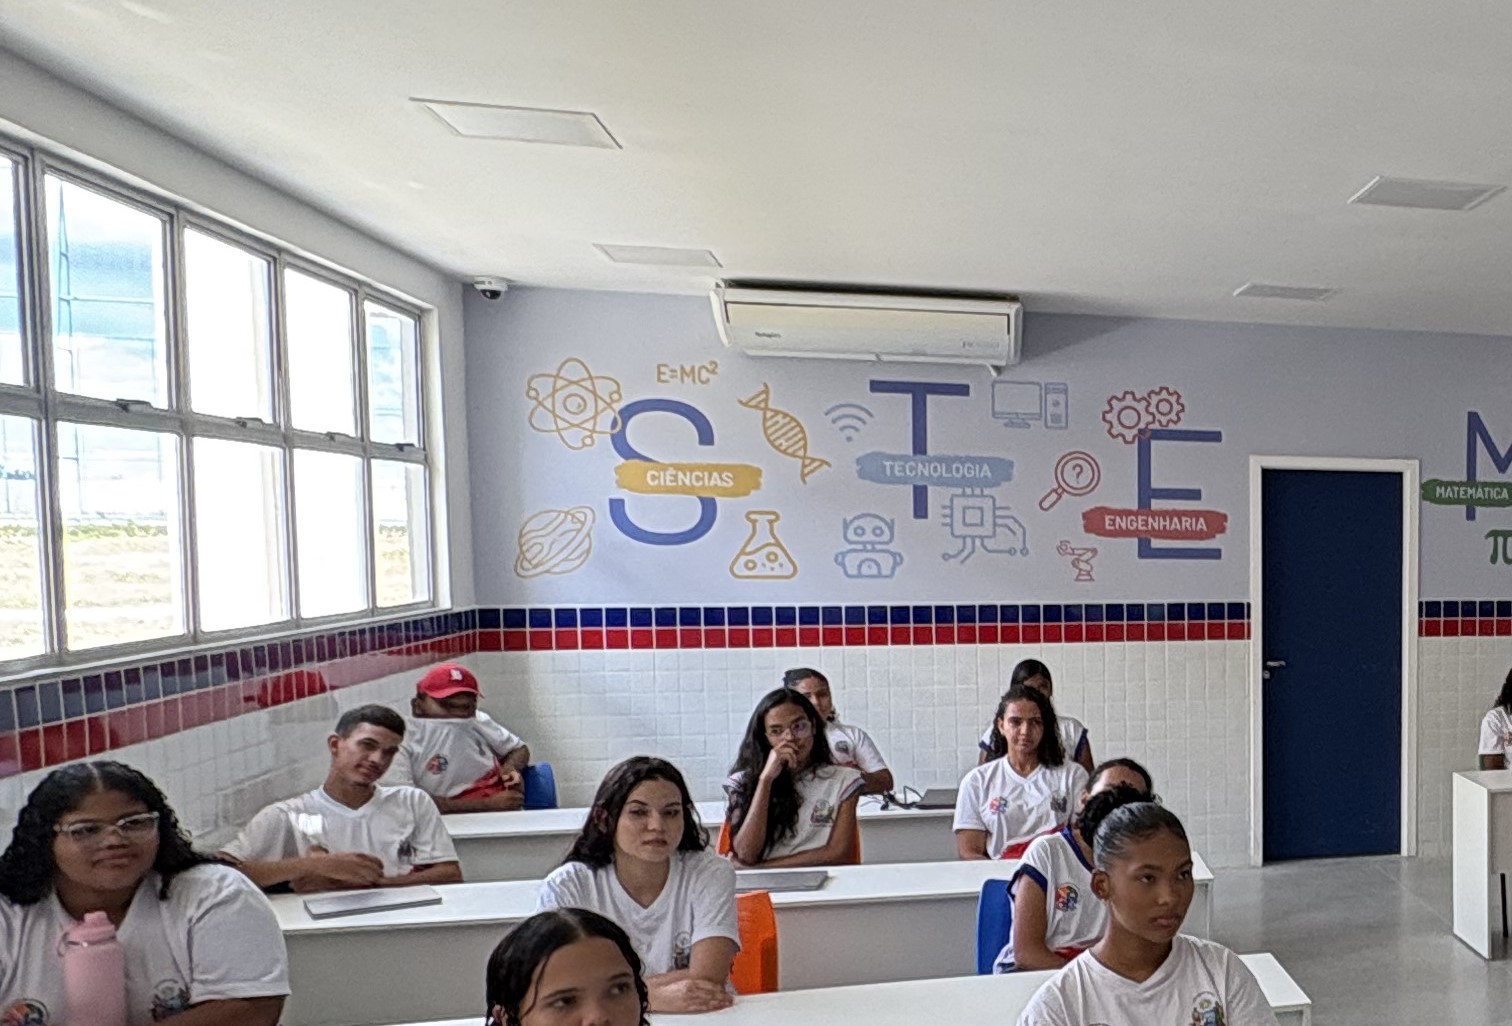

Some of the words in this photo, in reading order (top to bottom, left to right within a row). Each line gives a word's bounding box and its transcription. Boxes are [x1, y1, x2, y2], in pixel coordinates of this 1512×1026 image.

[869, 379, 970, 519] T
[609, 399, 717, 546] S
[646, 466, 734, 488] CIÊNCIAS
[883, 460, 992, 479] TECNOLOGIA
[1137, 428, 1222, 560] E
[1435, 484, 1510, 500] MATEMÁTICA
[1104, 514, 1208, 532] ENGENHARIA
